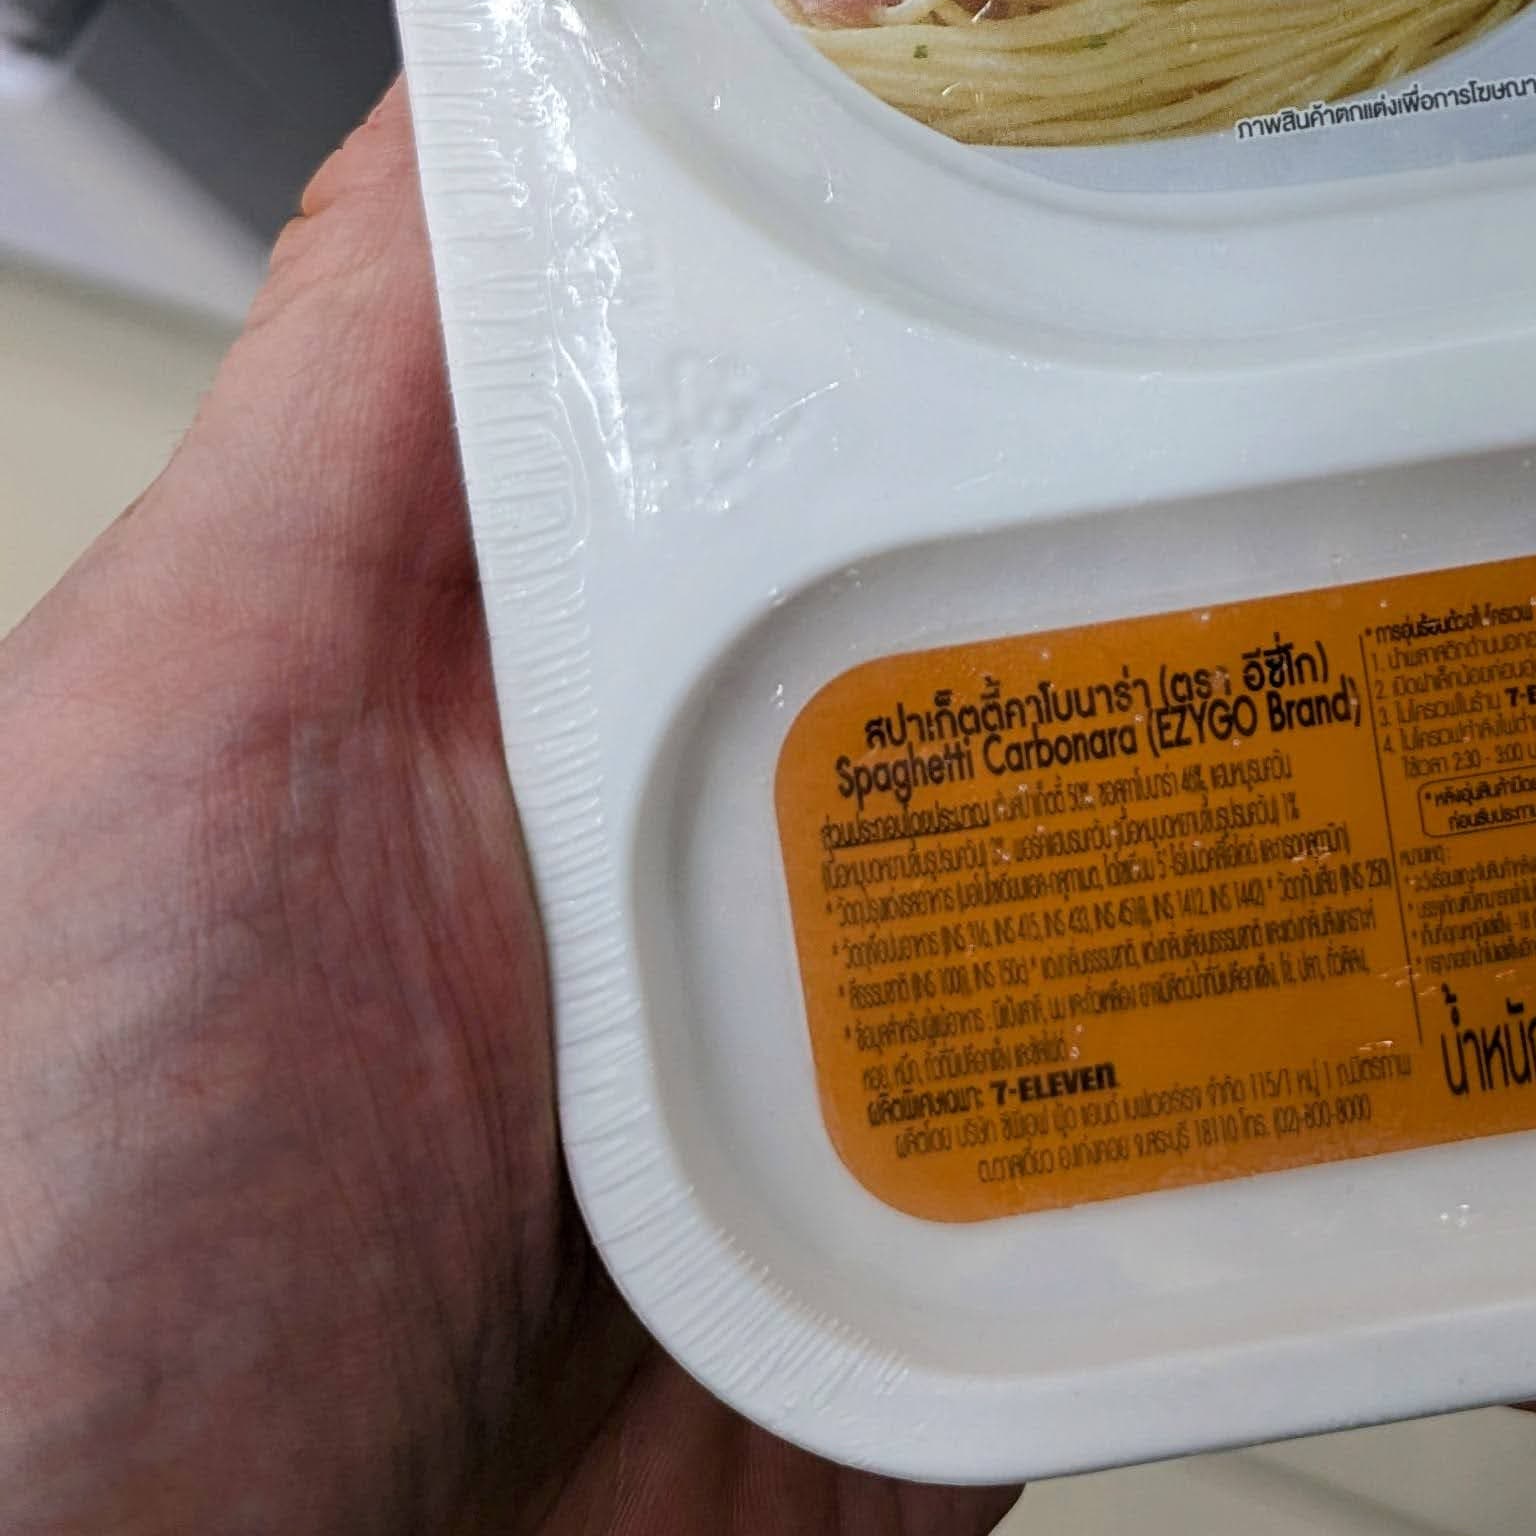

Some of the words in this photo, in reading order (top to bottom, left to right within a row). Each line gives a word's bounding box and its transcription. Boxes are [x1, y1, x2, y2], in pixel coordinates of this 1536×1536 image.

[836, 736, 975, 810] Spaghetti
[985, 720, 1139, 776] Carbonara
[1151, 697, 1259, 758] (EZYGO
